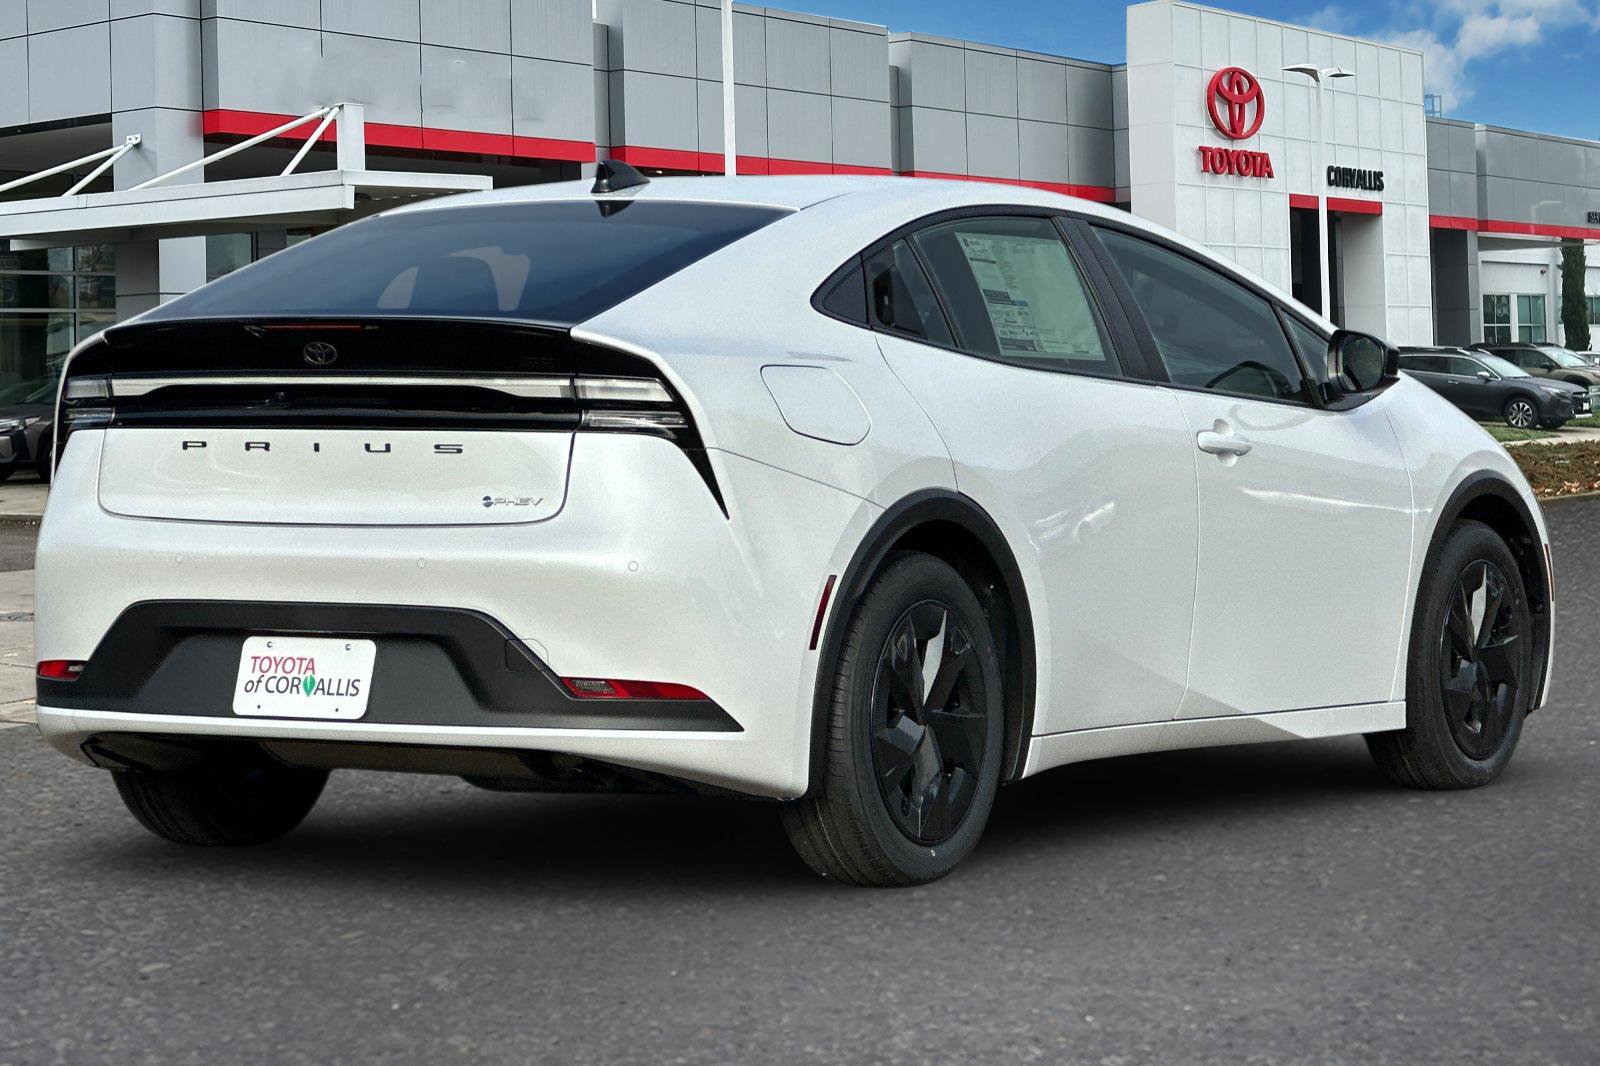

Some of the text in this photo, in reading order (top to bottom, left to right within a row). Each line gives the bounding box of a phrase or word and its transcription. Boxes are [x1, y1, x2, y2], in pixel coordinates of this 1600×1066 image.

[1198, 146, 1274, 179] TOYOTA
[1327, 165, 1385, 191] CORVALLIS
[182, 440, 463, 454] PRIUS
[251, 656, 316, 675] TOYOTA
[244, 674, 360, 698] of CORVALLIS
